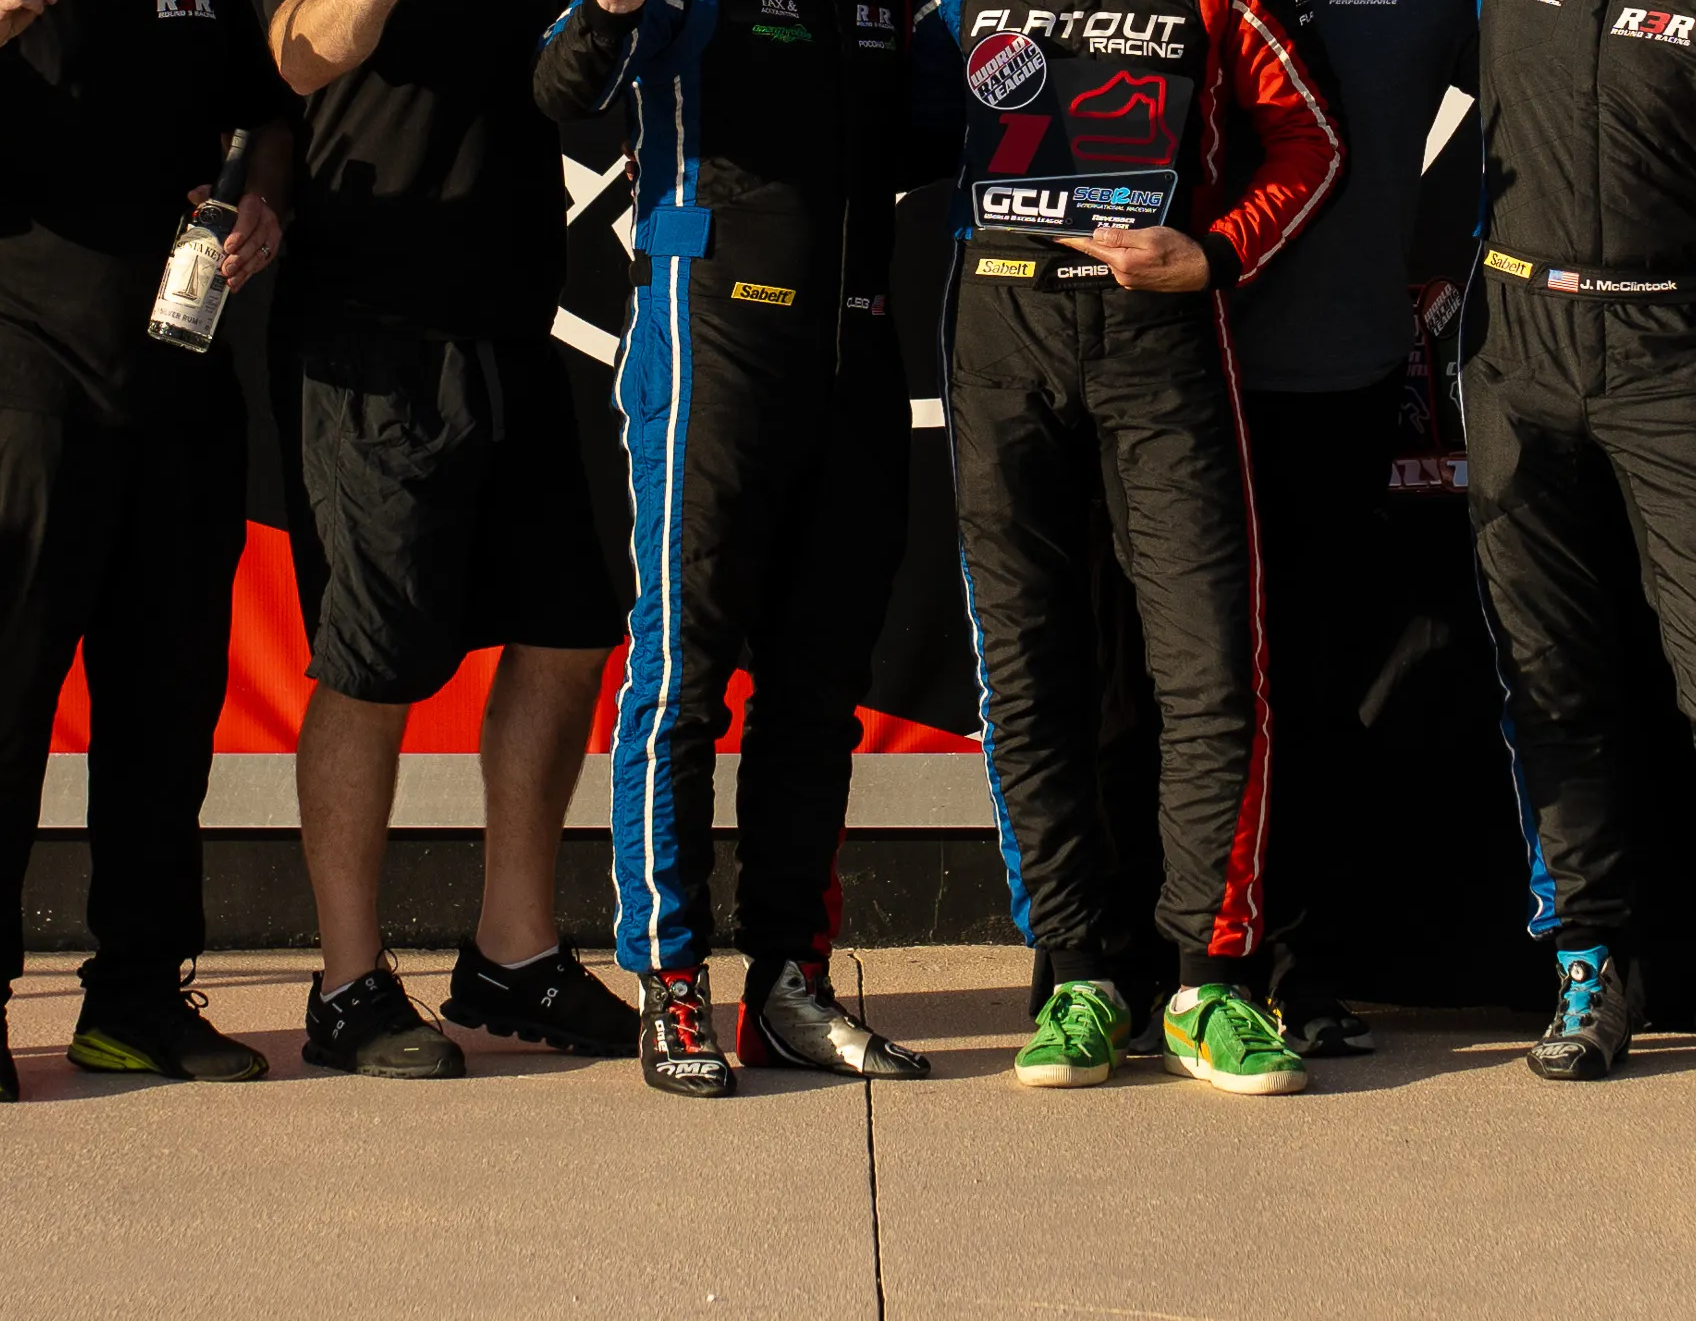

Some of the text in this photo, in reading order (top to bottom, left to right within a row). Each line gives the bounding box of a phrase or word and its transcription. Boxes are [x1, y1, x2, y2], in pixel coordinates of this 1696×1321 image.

[787, 0, 798, 12] &
[1610, 27, 1644, 39] ROUND
[1645, 32, 1653, 40] 3
[1613, 7, 1696, 40] R3R
[1089, 37, 1186, 59] RACING
[971, 36, 1031, 86] WORLD
[976, 44, 1040, 100] RACING
[986, 55, 1047, 107] LEAGUE
[987, 113, 1054, 176] 1
[982, 260, 1030, 276] Sabelt
[1490, 254, 1527, 276] Sabelt
[740, 284, 792, 303] Sabelt
[1579, 279, 1678, 292] J. McClintock
